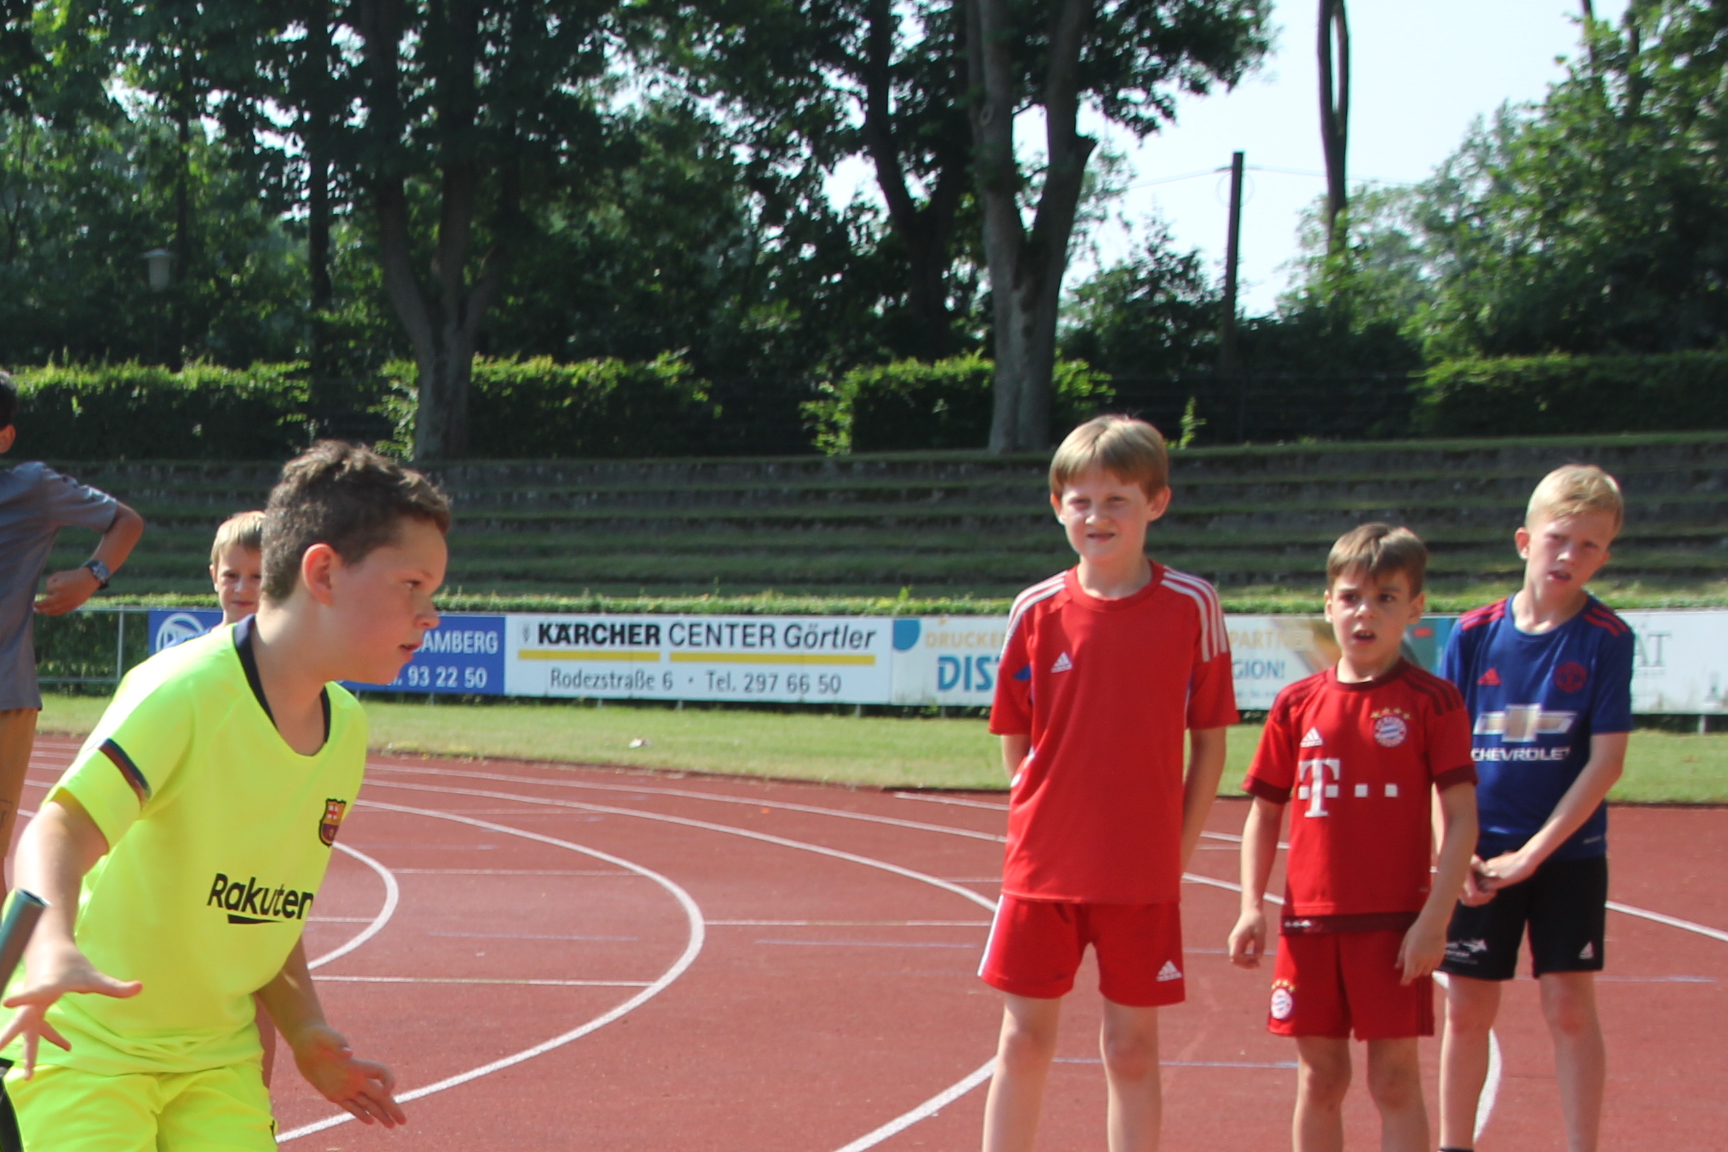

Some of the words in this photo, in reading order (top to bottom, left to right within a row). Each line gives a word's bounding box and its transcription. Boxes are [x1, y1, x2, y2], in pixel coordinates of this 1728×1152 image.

[418, 630, 498, 655] AMBERG
[538, 621, 660, 646] KÄRCHER
[669, 623, 775, 648] CENTER
[783, 624, 876, 650] Görtler
[408, 666, 430, 687] 93
[436, 667, 458, 688] 22
[464, 667, 487, 689] 50
[550, 667, 654, 691] Rodezstraße
[662, 671, 673, 690] 6
[706, 671, 736, 692] Tel.
[743, 673, 777, 693] 297
[786, 675, 810, 694] 66
[818, 675, 841, 694] 50
[937, 654, 1000, 691] DIS
[1470, 746, 1571, 762] CHEVROLET
